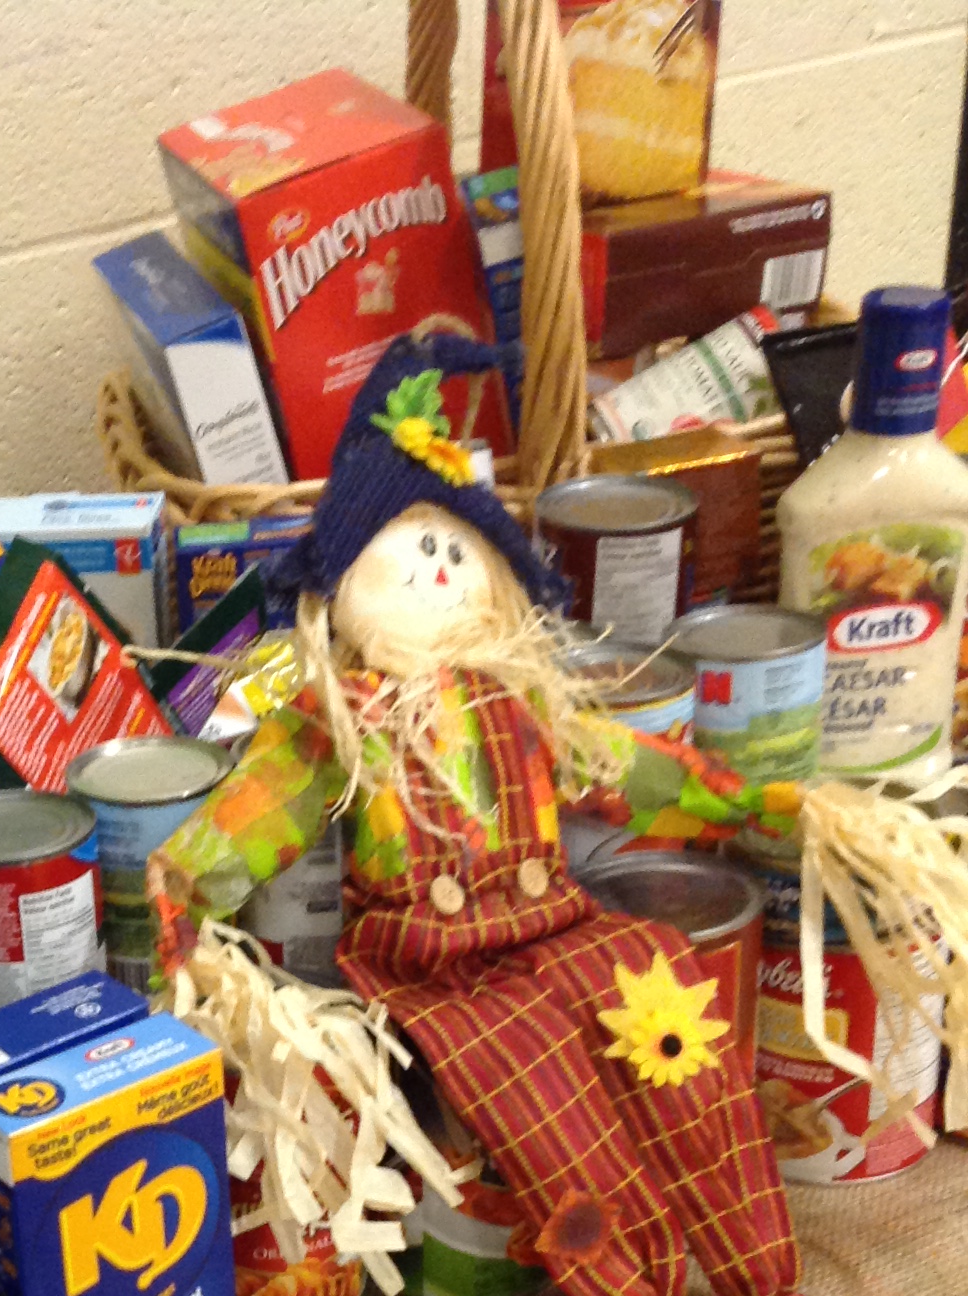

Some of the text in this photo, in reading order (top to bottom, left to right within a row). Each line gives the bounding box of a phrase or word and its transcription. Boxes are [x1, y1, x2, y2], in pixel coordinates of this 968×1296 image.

[260, 175, 448, 331] Honeycomb
[847, 611, 914, 642] Kraft
[832, 667, 906, 692] AESAR
